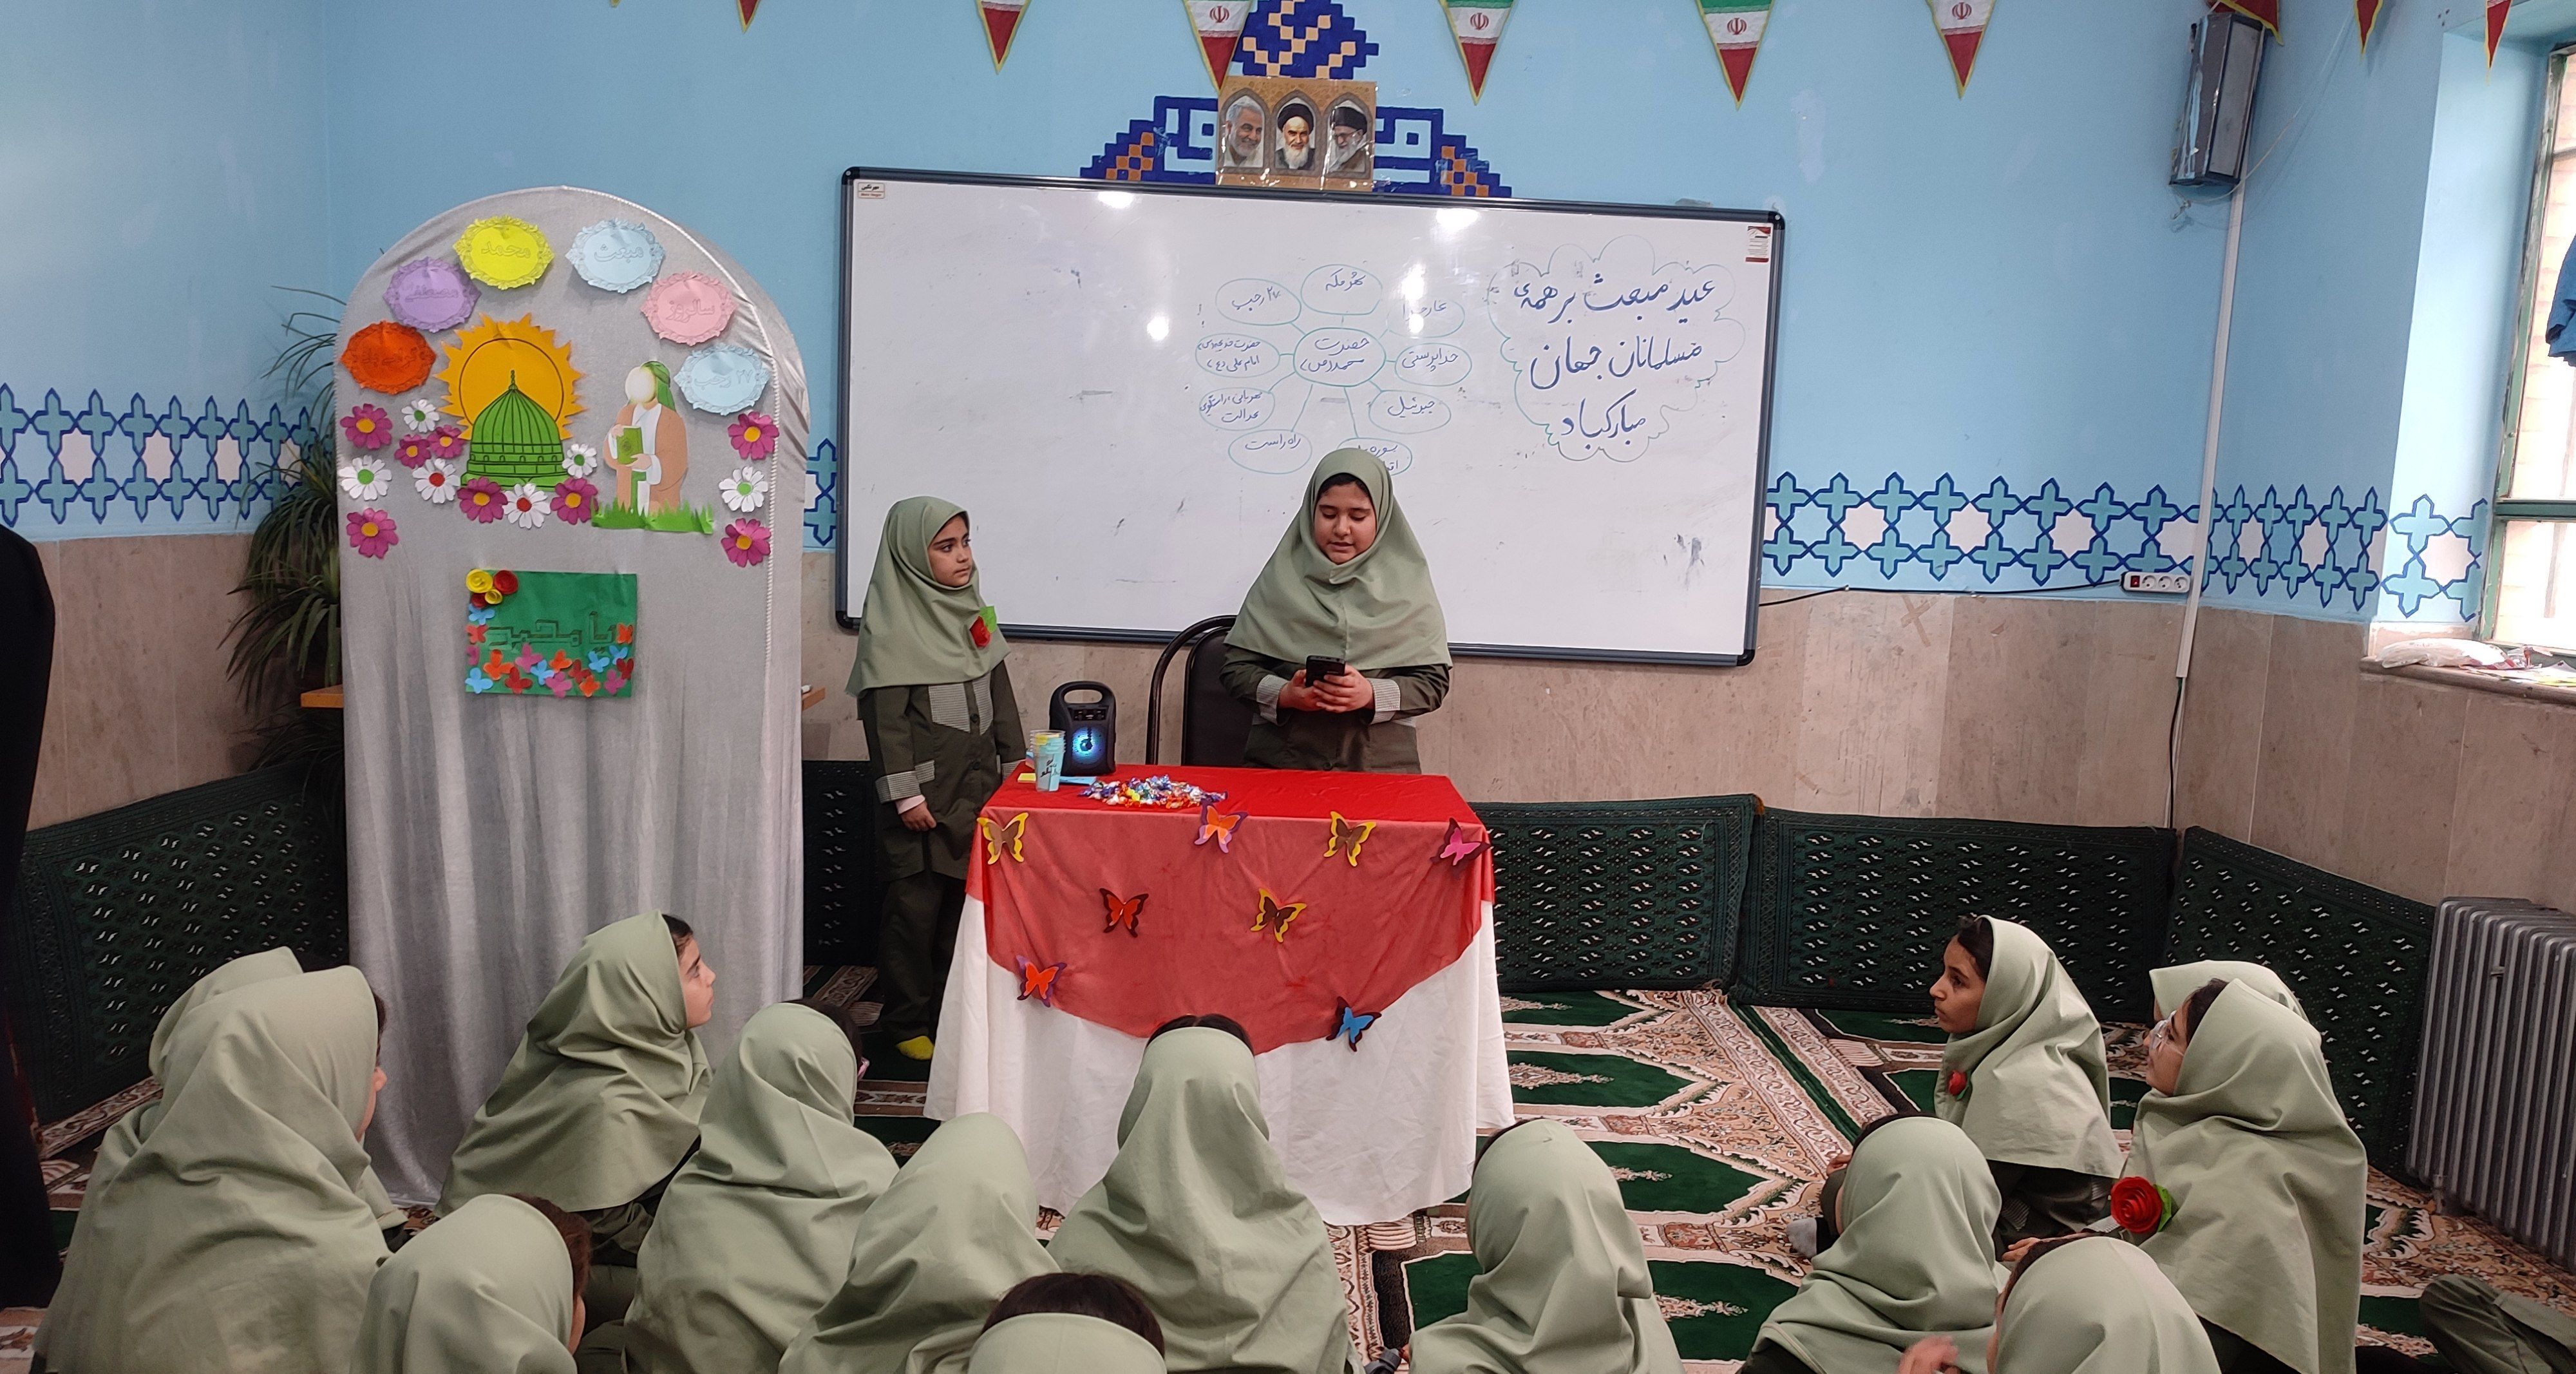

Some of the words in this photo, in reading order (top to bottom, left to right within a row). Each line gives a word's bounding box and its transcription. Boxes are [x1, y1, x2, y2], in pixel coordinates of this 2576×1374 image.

[481, 241, 531, 258] محمد
[593, 243, 644, 263] مبعث
[1231, 294, 1265, 311] رجب
[1584, 273, 1669, 321] مبعث
[1666, 280, 1716, 323] عید
[665, 298, 715, 323] سالروز
[1314, 338, 1370, 356] حضرت
[1226, 358, 1242, 372] علی
[1245, 356, 1260, 371] امام
[1530, 336, 1602, 390] جهان
[1609, 336, 1703, 377] مسلمانان
[694, 375, 732, 390] رجب
[735, 369, 752, 385] ۲۷
[1221, 408, 1260, 423] عدالت
[1245, 434, 1285, 450] راست
